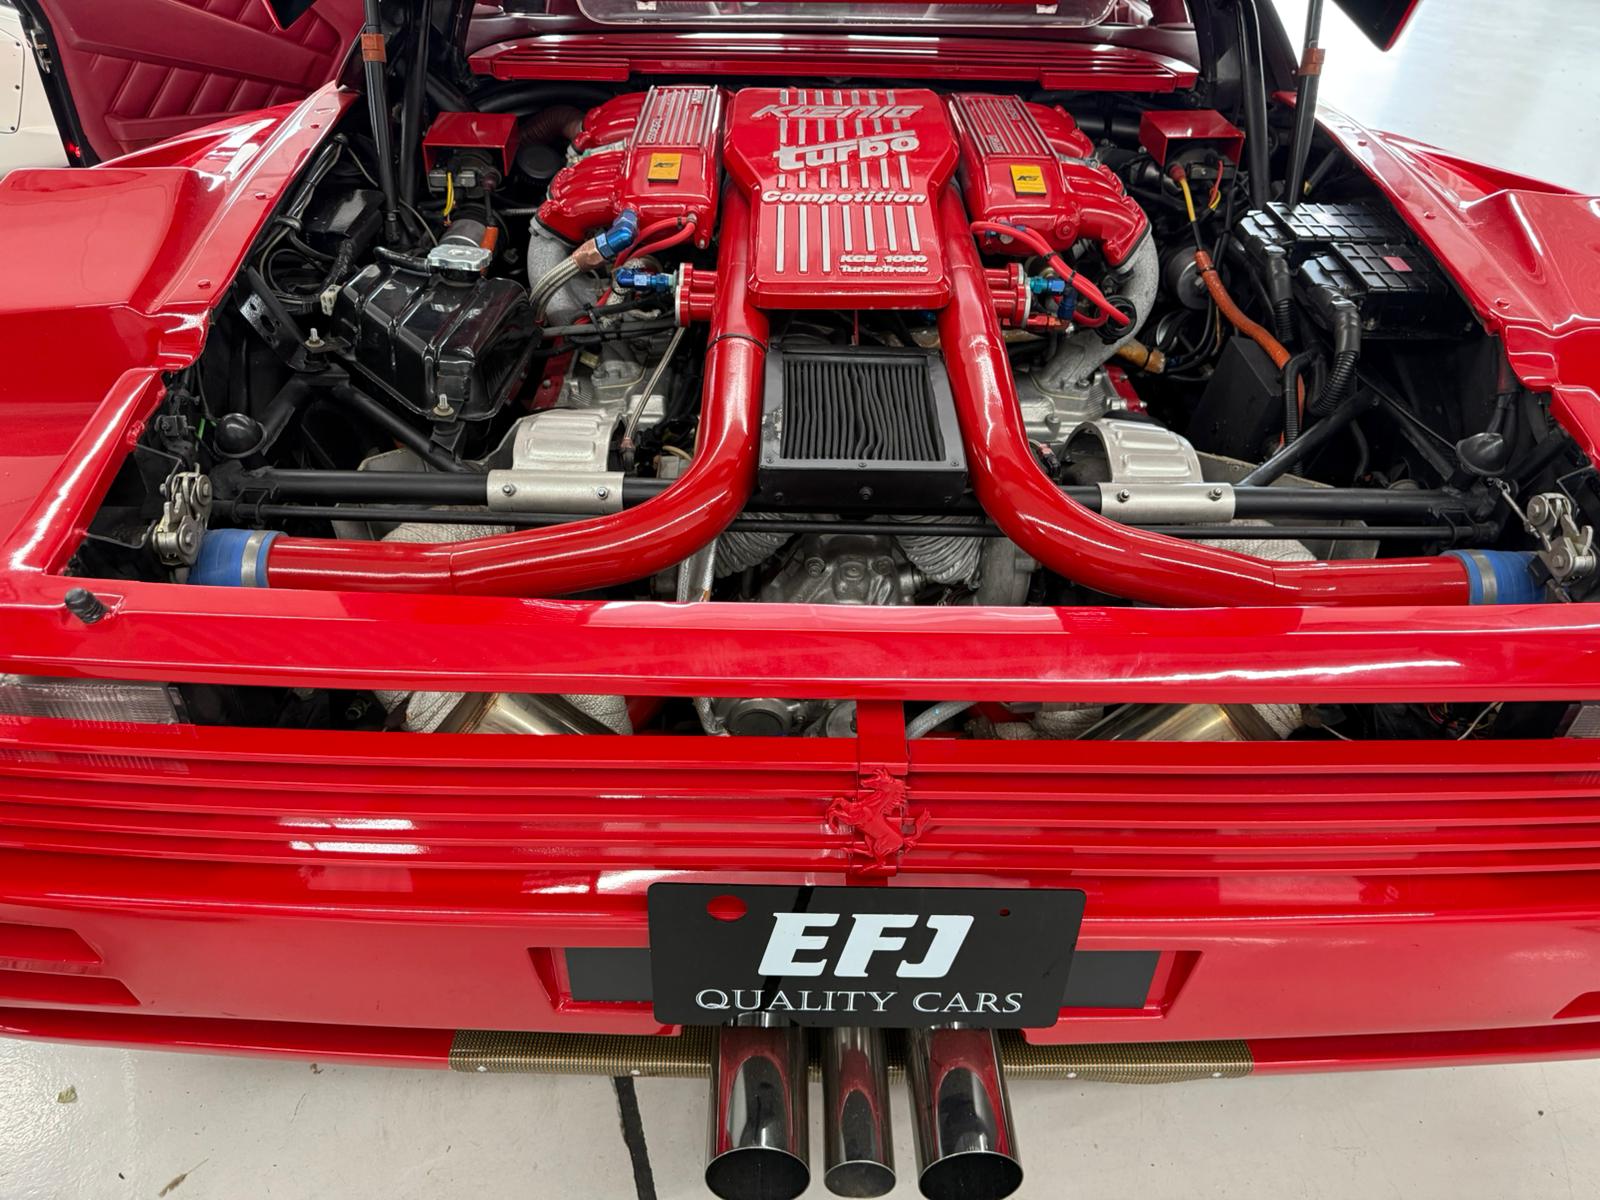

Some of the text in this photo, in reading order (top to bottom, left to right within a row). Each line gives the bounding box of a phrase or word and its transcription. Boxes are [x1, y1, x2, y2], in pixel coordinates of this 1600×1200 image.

[773, 130, 920, 171] turbo
[761, 190, 928, 204] Competition
[840, 255, 928, 263] KCE 1000
[757, 912, 975, 978] EFJ
[695, 989, 1023, 1013] QUALITY CARS
